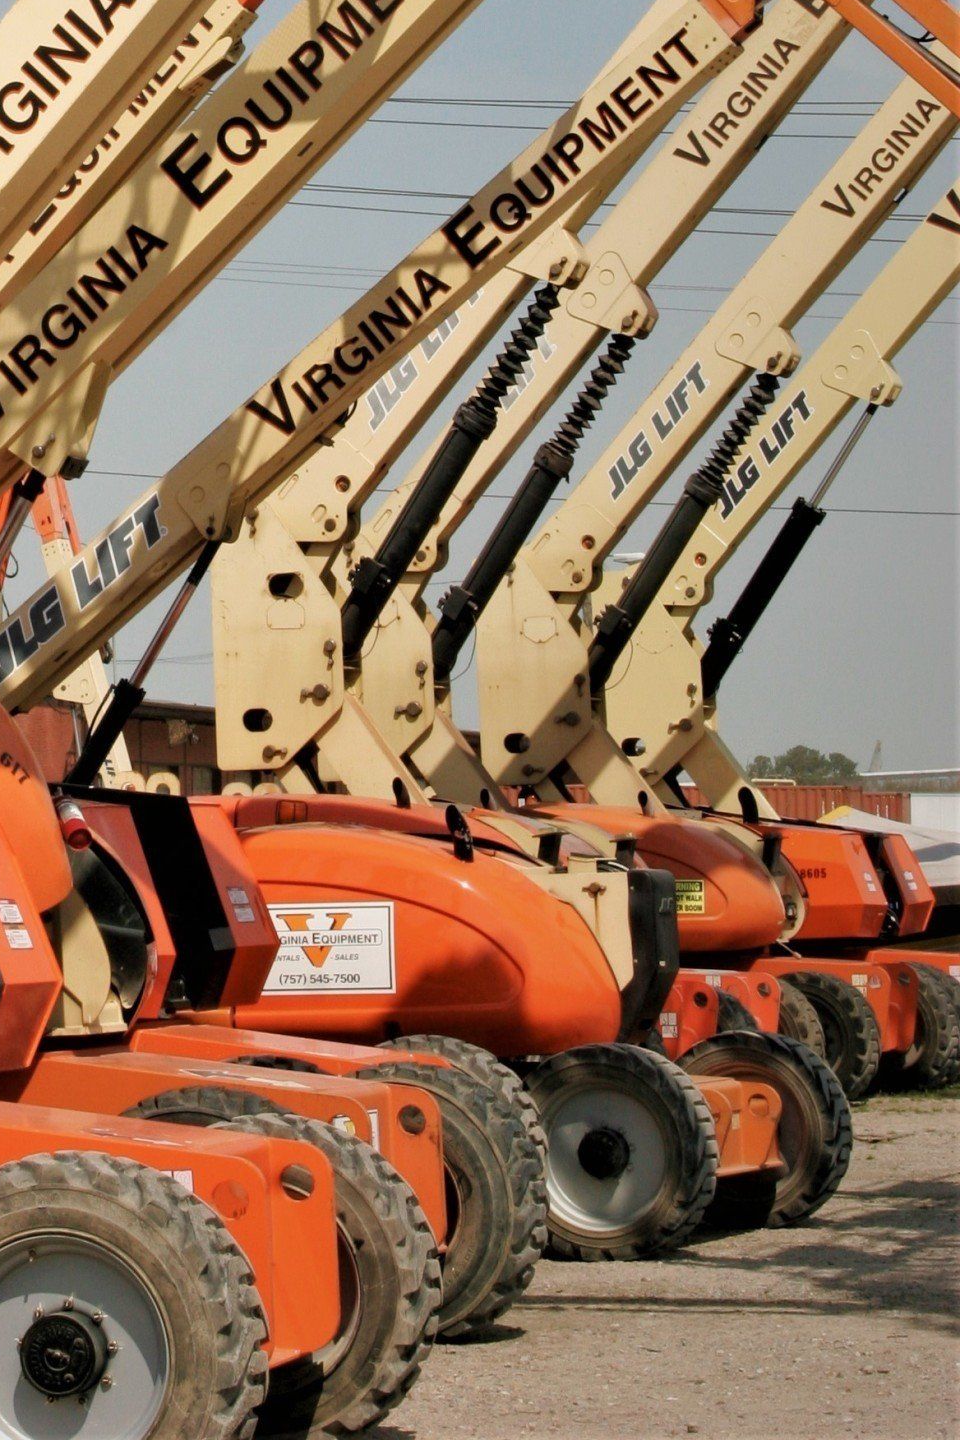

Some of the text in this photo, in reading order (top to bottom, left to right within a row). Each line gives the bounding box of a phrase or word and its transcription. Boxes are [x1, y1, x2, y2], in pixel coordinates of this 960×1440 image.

[673, 35, 801, 168] VIRGINIA
[820, 98, 941, 218] VIRGINIA
[244, 268, 452, 439] VIRGINIA
[441, 26, 704, 271] EQUIPMENT
[366, 354, 419, 432] JLG
[607, 359, 707, 501] JLG LIFT
[758, 389, 812, 465] LIFT
[70, 490, 163, 611] LIFT
[280, 932, 378, 944] GINIA EQUIPMENT
[310, 974, 360, 983] 545-7500
